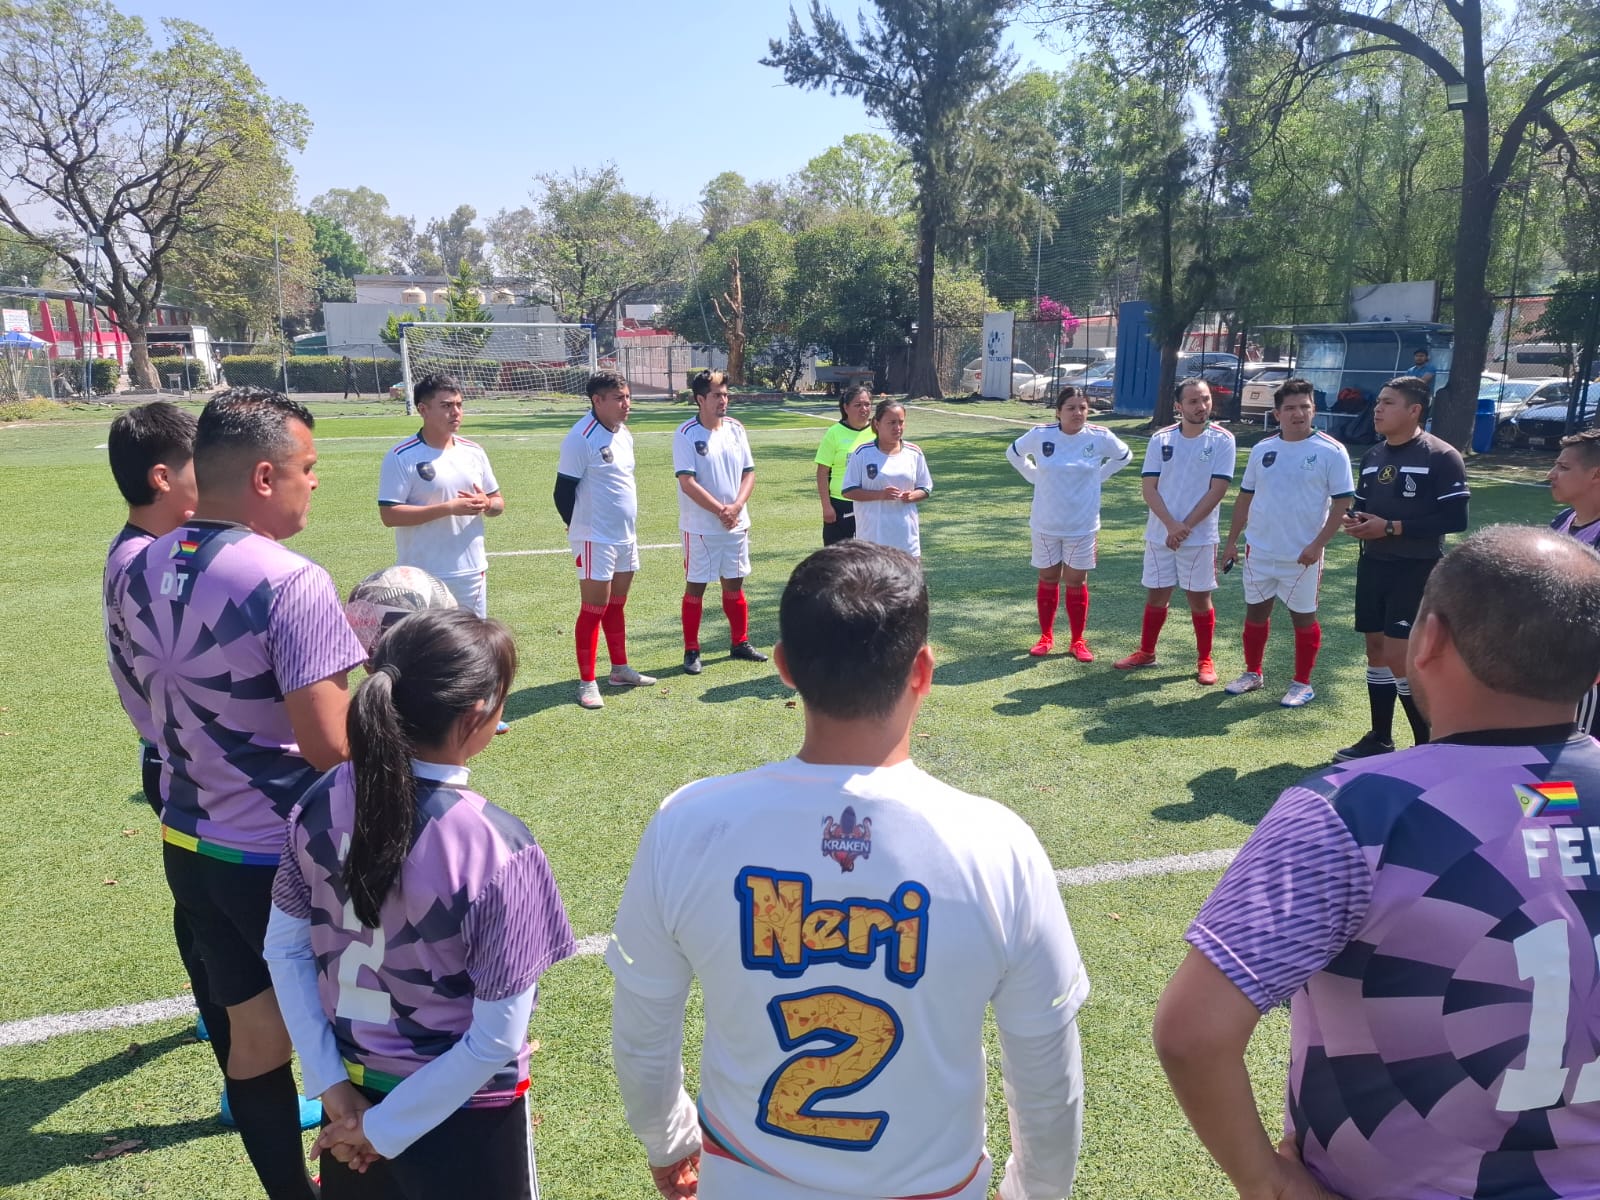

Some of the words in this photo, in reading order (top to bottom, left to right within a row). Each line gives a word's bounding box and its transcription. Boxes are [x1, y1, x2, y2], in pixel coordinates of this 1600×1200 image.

[160, 571, 189, 596] DT
[824, 840, 870, 853] KRAKEN
[735, 865, 931, 988] Neri
[756, 985, 904, 1152] 2
